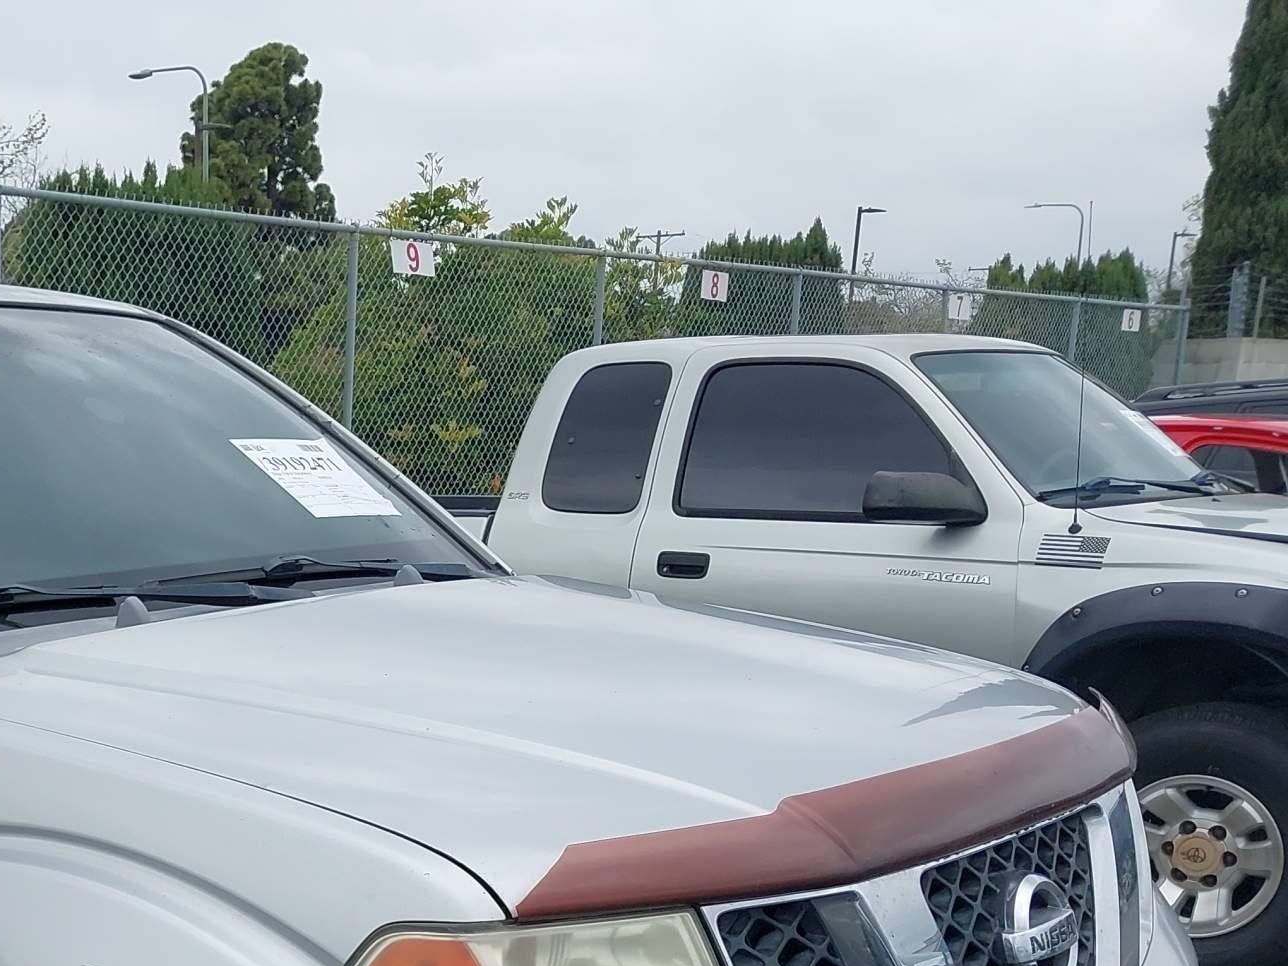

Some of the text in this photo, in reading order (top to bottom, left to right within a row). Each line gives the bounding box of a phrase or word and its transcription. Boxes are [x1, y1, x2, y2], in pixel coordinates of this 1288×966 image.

[407, 242, 420, 272] 9
[711, 273, 720, 299] 8
[957, 295, 964, 318] 7
[1127, 311, 1136, 330] 6
[262, 456, 343, 472] 39192471
[919, 570, 991, 585] TACOMA
